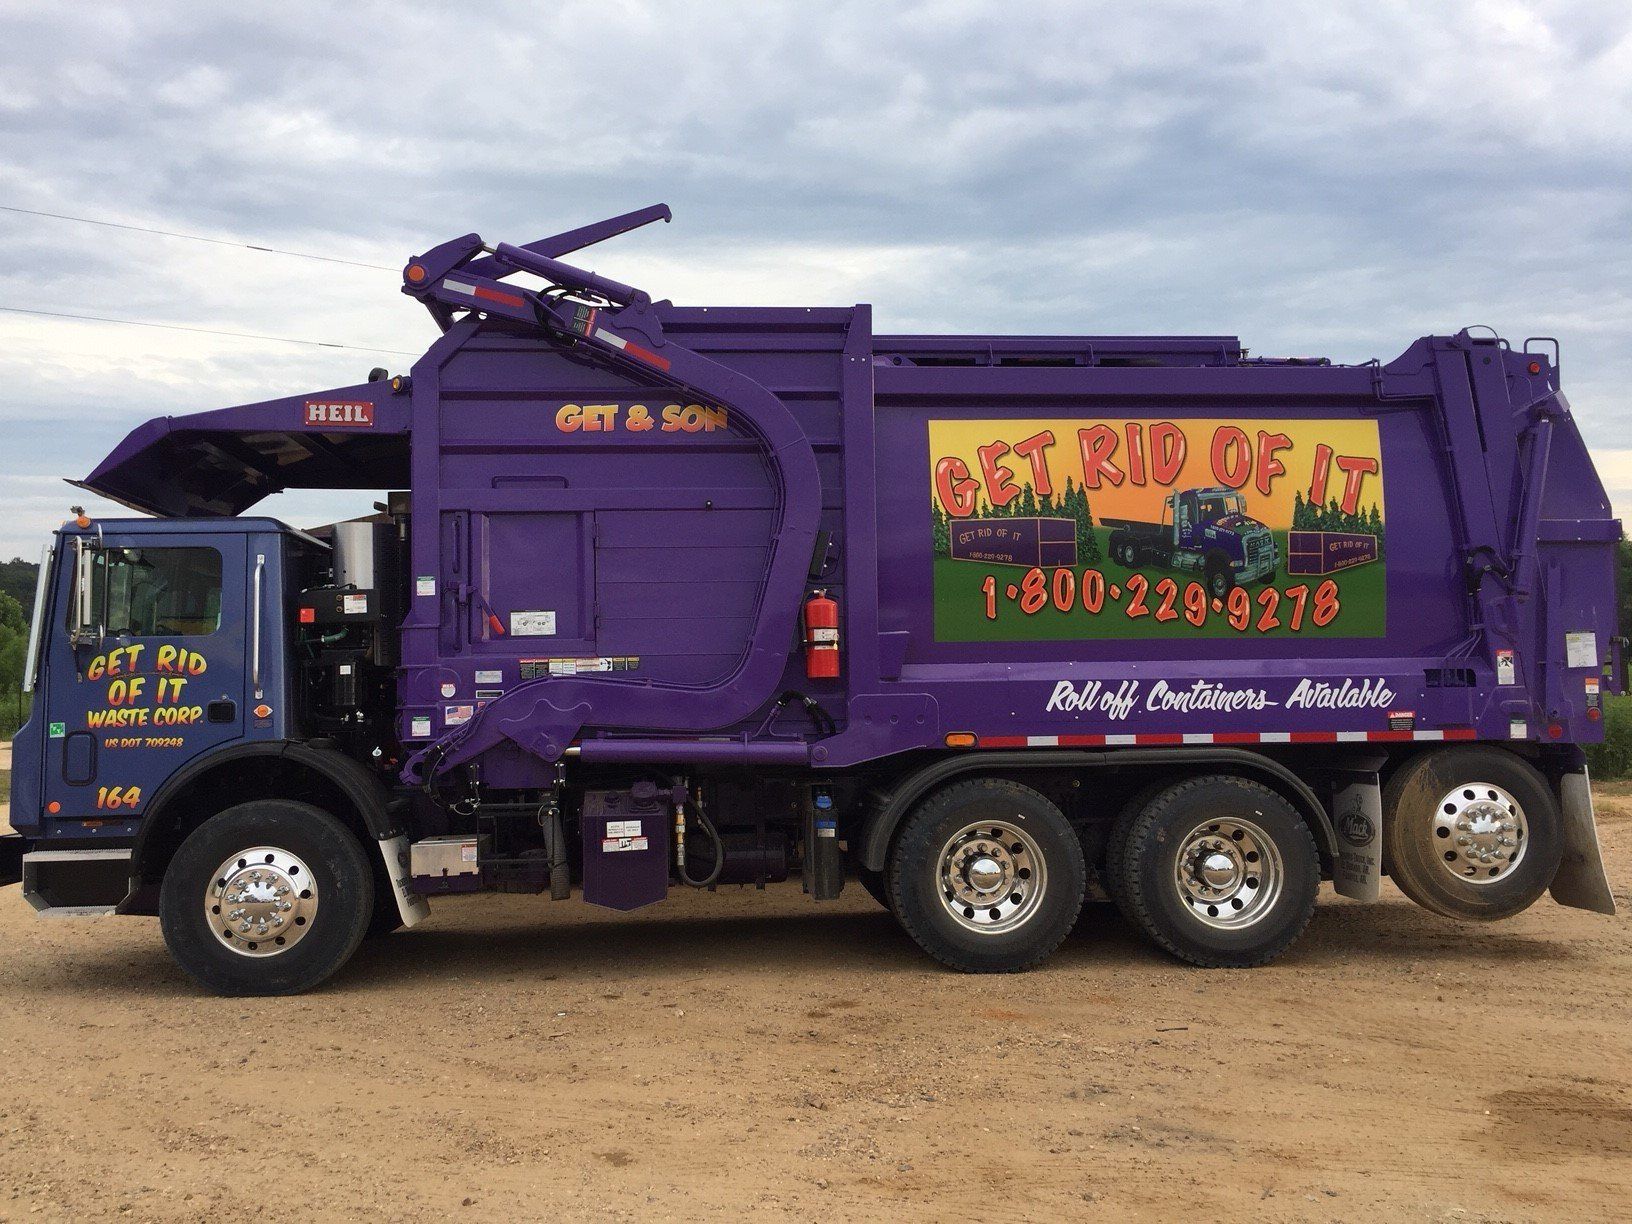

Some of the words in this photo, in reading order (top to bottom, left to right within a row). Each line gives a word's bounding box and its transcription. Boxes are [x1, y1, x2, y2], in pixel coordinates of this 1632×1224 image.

[308, 405, 369, 423] HEIL
[555, 404, 619, 433] GET
[625, 404, 656, 432] &
[661, 404, 728, 433] SON
[935, 430, 1057, 518] GET
[1077, 421, 1188, 490] RID
[1210, 425, 1293, 498] OF
[1309, 443, 1378, 516] IT
[959, 531, 976, 544] GET
[978, 528, 992, 538] RID
[996, 528, 1008, 538] OF
[1013, 531, 1021, 541] IT
[1329, 542, 1342, 551] GET
[1343, 541, 1354, 549] RID
[87, 644, 145, 681] GET
[157, 644, 208, 676] RID
[108, 677, 146, 706] OF
[156, 677, 188, 704] IT
[1045, 680, 1101, 713] Roll
[1099, 680, 1140, 721] off
[1146, 679, 1279, 713] Containers
[1285, 677, 1397, 709] Available
[87, 707, 150, 729] WASTE
[153, 705, 204, 727] CORP.
[105, 738, 119, 748] US
[120, 738, 142, 748] DOT
[145, 737, 184, 748] 709248
[96, 786, 143, 810] 164
